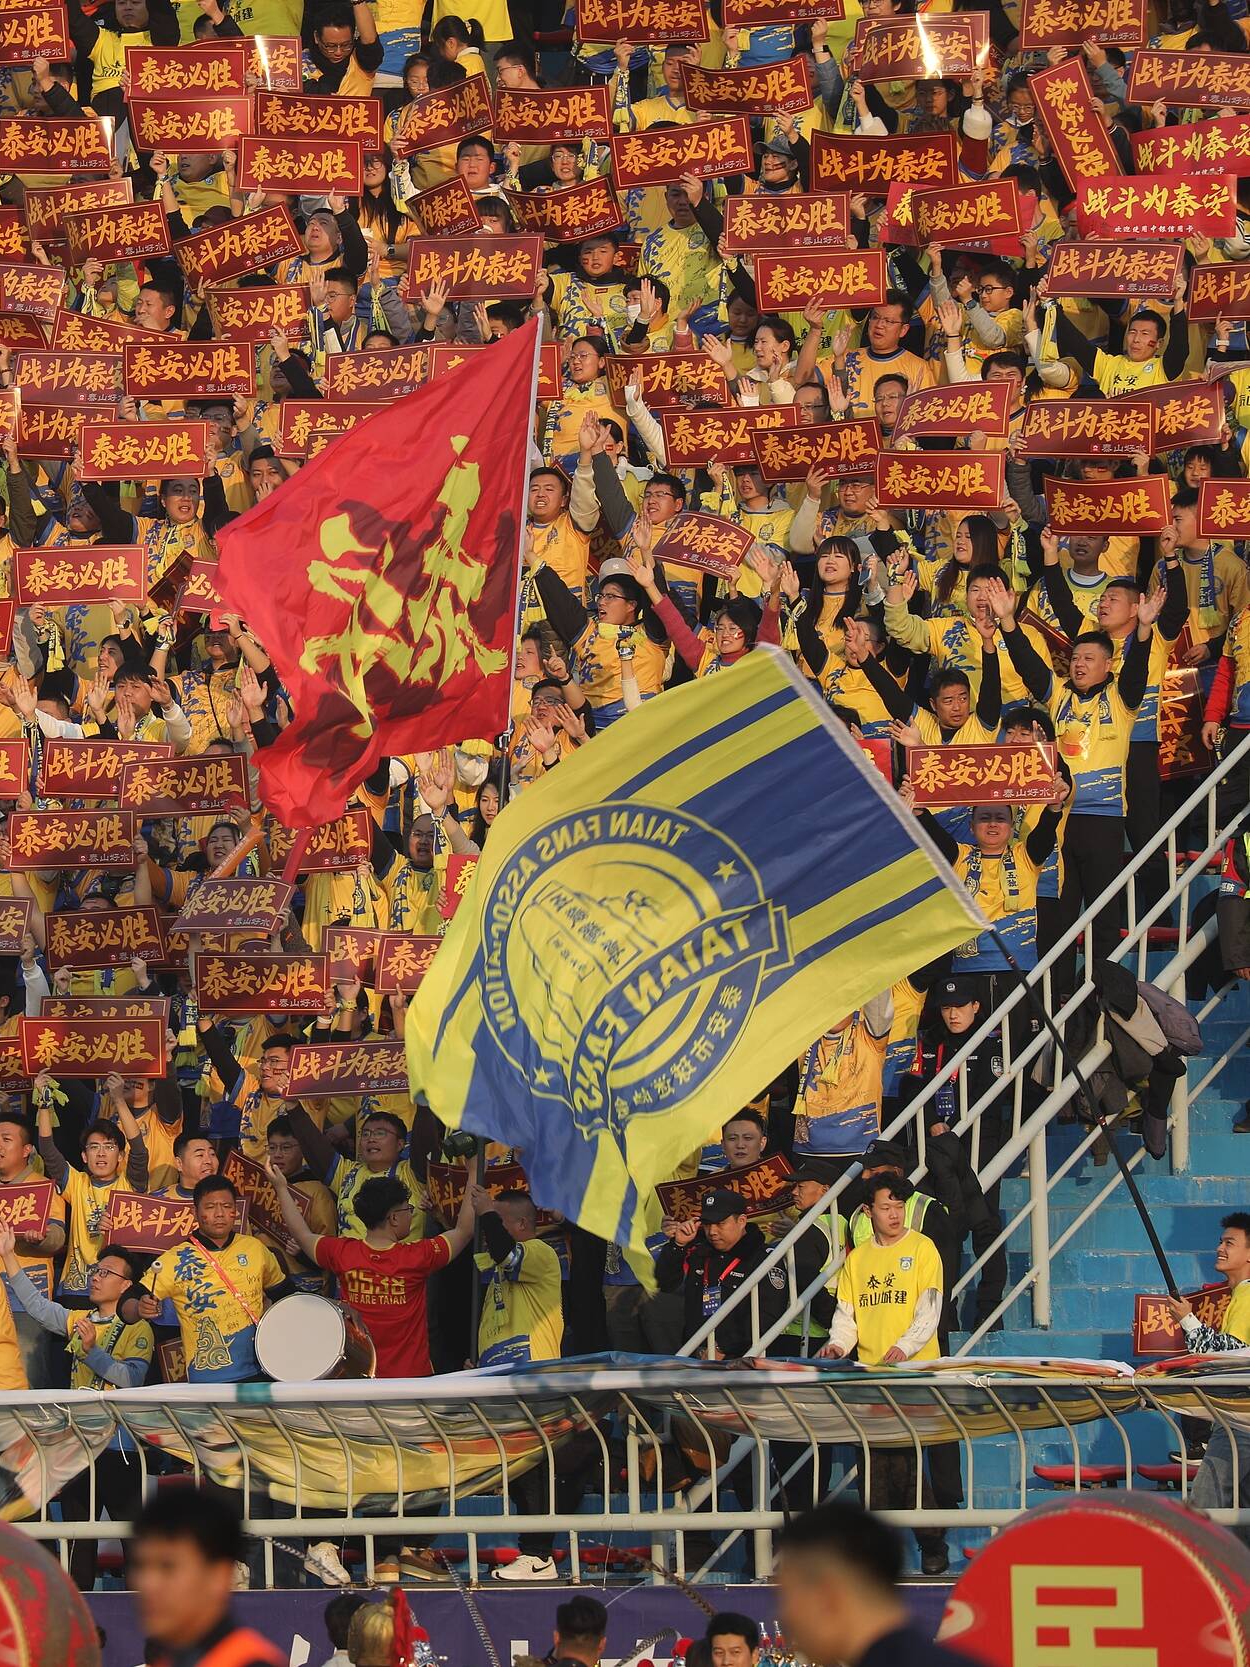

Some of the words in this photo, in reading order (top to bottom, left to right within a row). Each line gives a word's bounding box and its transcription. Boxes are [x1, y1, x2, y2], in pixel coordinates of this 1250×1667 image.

[582, 0, 700, 30] 战斗为泰安
[1025, 1, 1142, 35] 泰安必胜
[138, 58, 239, 92] 泰安必胜
[689, 67, 807, 102] 泰安必胜
[140, 109, 242, 142] 泰安必胜
[263, 98, 379, 136] 泰安必胜
[498, 94, 605, 129] 泰安必胜
[0, 123, 109, 160] 泰安必胜
[619, 125, 746, 174] 泰安必胜
[248, 146, 355, 182] 泰安必胜
[817, 148, 946, 183] 战斗为泰安
[728, 200, 844, 239] 泰安必胜
[1083, 184, 1230, 219] 战斗为泰安
[180, 215, 291, 281] 战斗为泰安
[1053, 249, 1176, 281] 战斗为泰安
[415, 250, 532, 287] 战斗为泰安
[766, 262, 876, 300] 泰安必胜
[129, 346, 248, 385] 泰安必胜
[902, 391, 1000, 429] 泰安必胜
[1026, 408, 1150, 441] 战斗为泰安
[89, 432, 201, 469] 泰安必胜
[761, 426, 876, 470] 泰安必胜
[884, 462, 992, 496] 泰安必胜
[1051, 490, 1161, 524] 泰安必胜
[25, 557, 138, 593] 泰安必胜
[124, 761, 243, 805] 泰安必胜
[915, 751, 1052, 792] 泰安必胜
[13, 817, 131, 856] 泰安必胜
[52, 915, 158, 956] 泰安必胜
[203, 959, 324, 998] 泰安必胜
[32, 1029, 155, 1066] 泰安必胜
[859, 1290, 907, 1307] 泰山城建
[867, 1273, 896, 1289] 泰安
